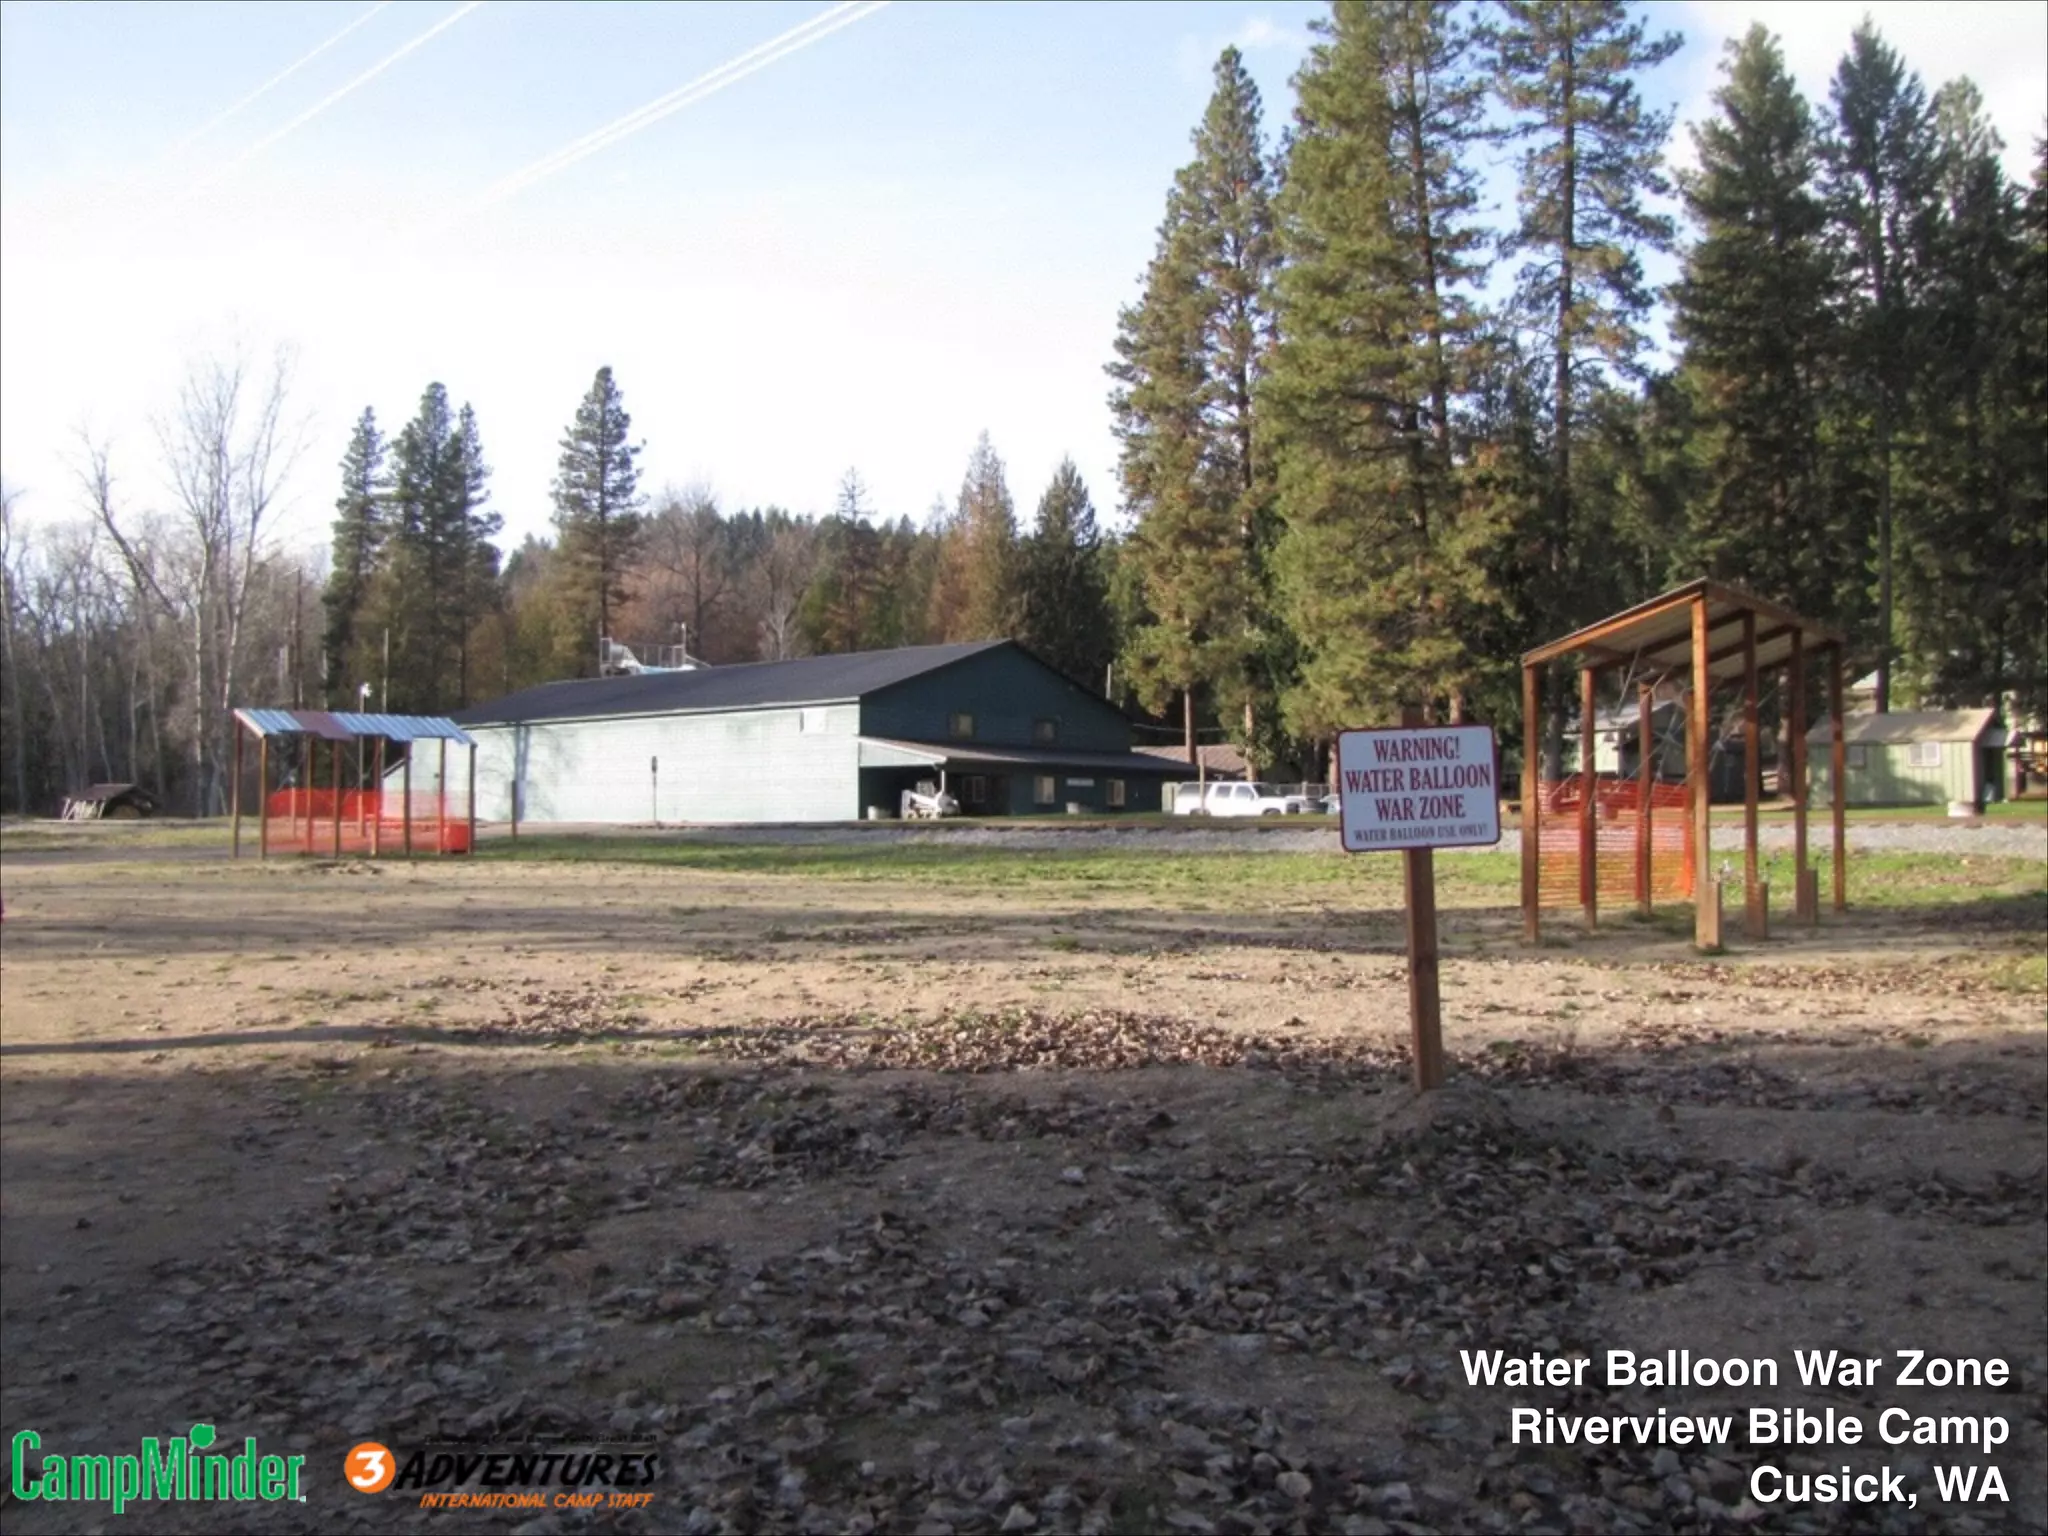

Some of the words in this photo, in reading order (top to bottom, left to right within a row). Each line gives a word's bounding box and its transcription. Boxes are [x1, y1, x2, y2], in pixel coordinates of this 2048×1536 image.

[1373, 736, 1460, 763] WARNING!
[1345, 768, 1405, 793] WATER
[1409, 763, 1491, 791] BALLOON
[1375, 797, 1415, 821] WAR
[1419, 794, 1466, 820] ZONE
[1354, 829, 1387, 842] WATER
[1389, 826, 1435, 840] BALLOON
[1437, 825, 1457, 838] USE
